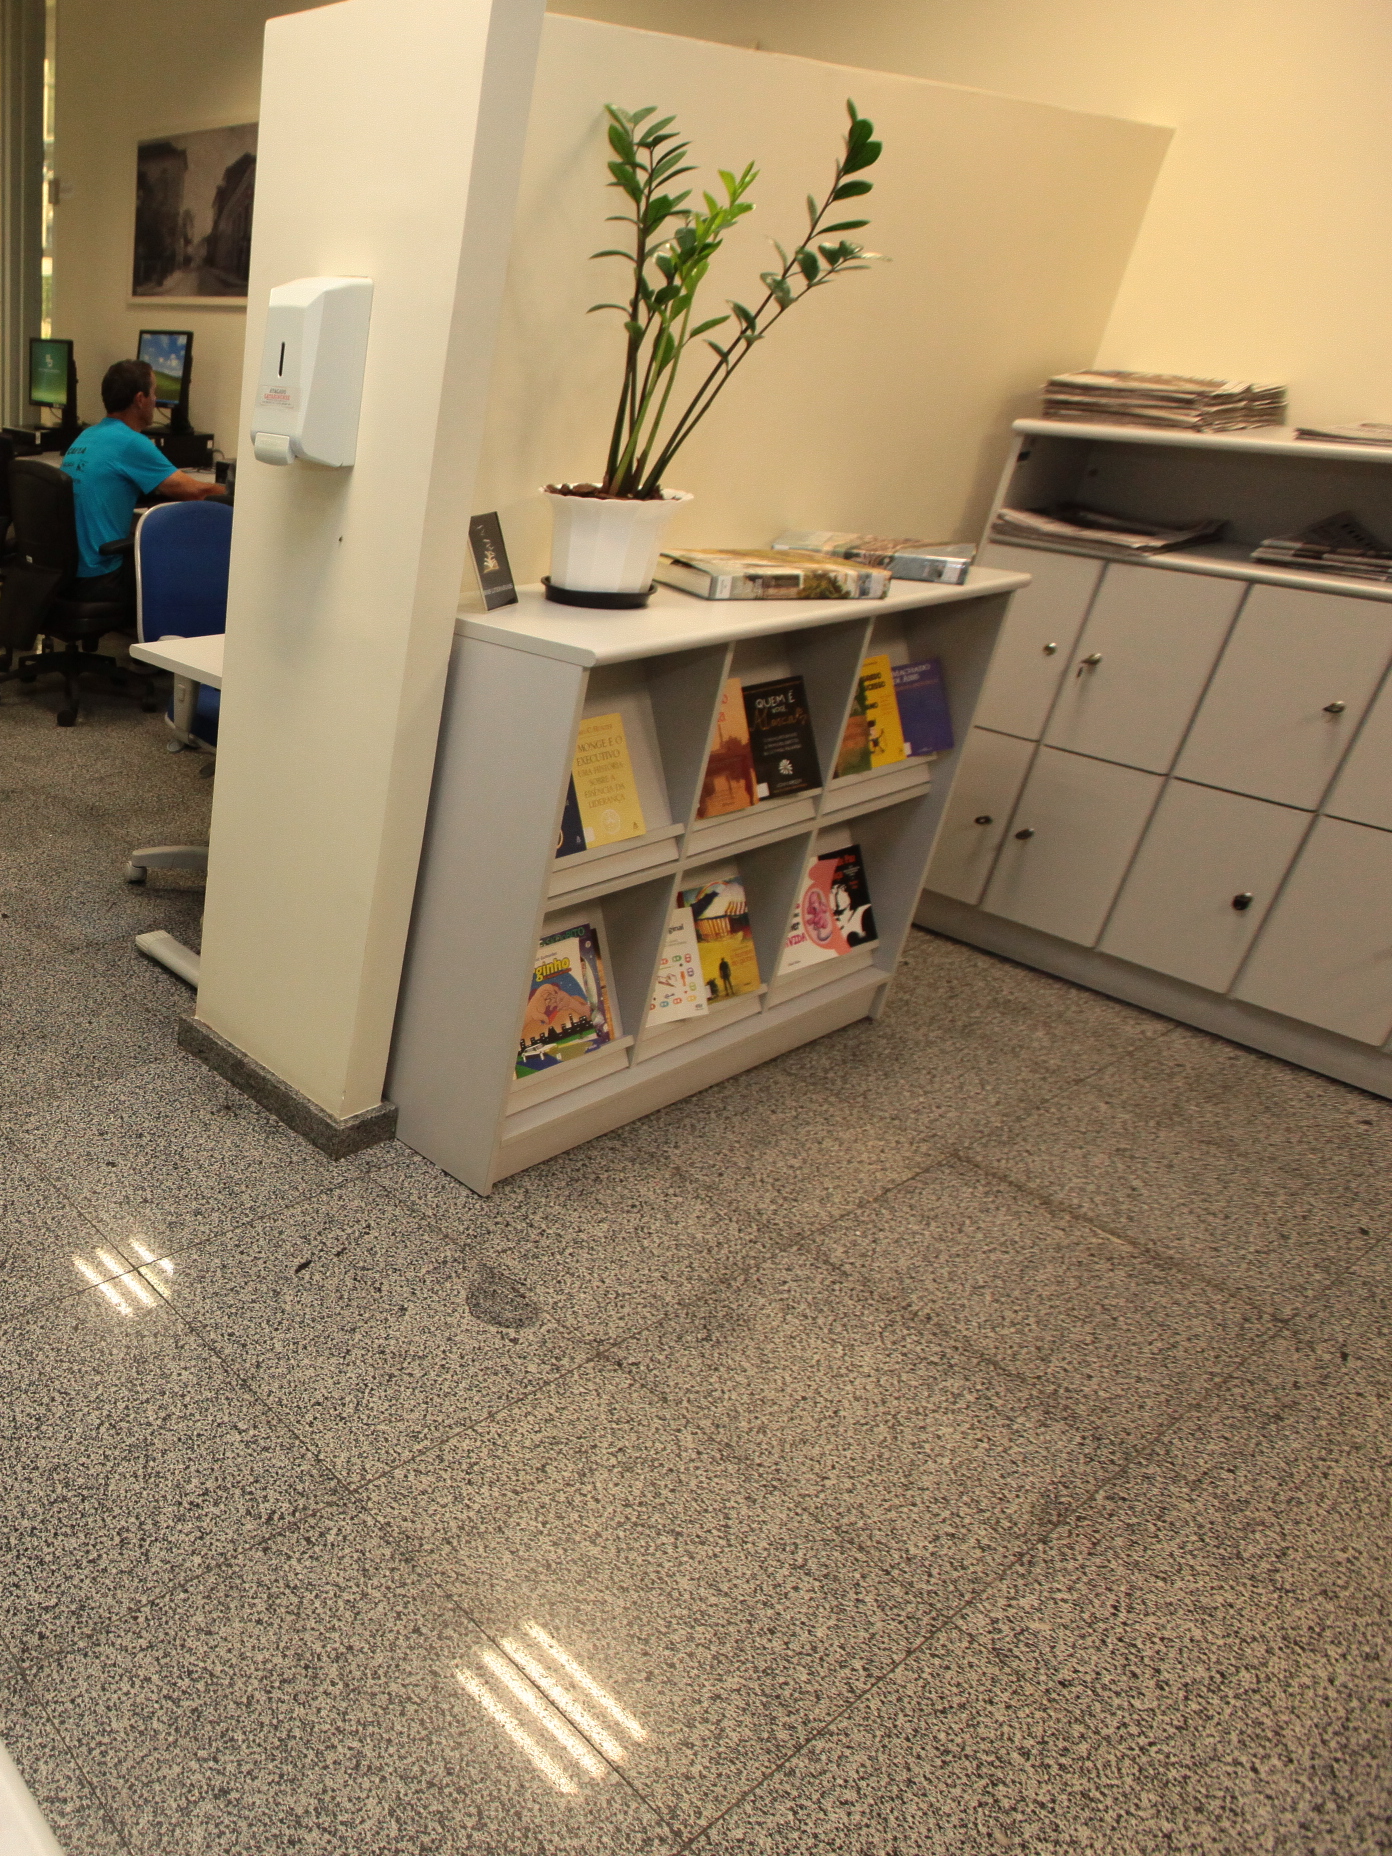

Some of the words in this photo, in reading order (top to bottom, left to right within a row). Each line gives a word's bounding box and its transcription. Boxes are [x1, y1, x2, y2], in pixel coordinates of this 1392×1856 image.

[755, 695, 785, 708] QUEM
[577, 738, 606, 753] MONGE
[577, 750, 620, 766] EXECUTIVO
